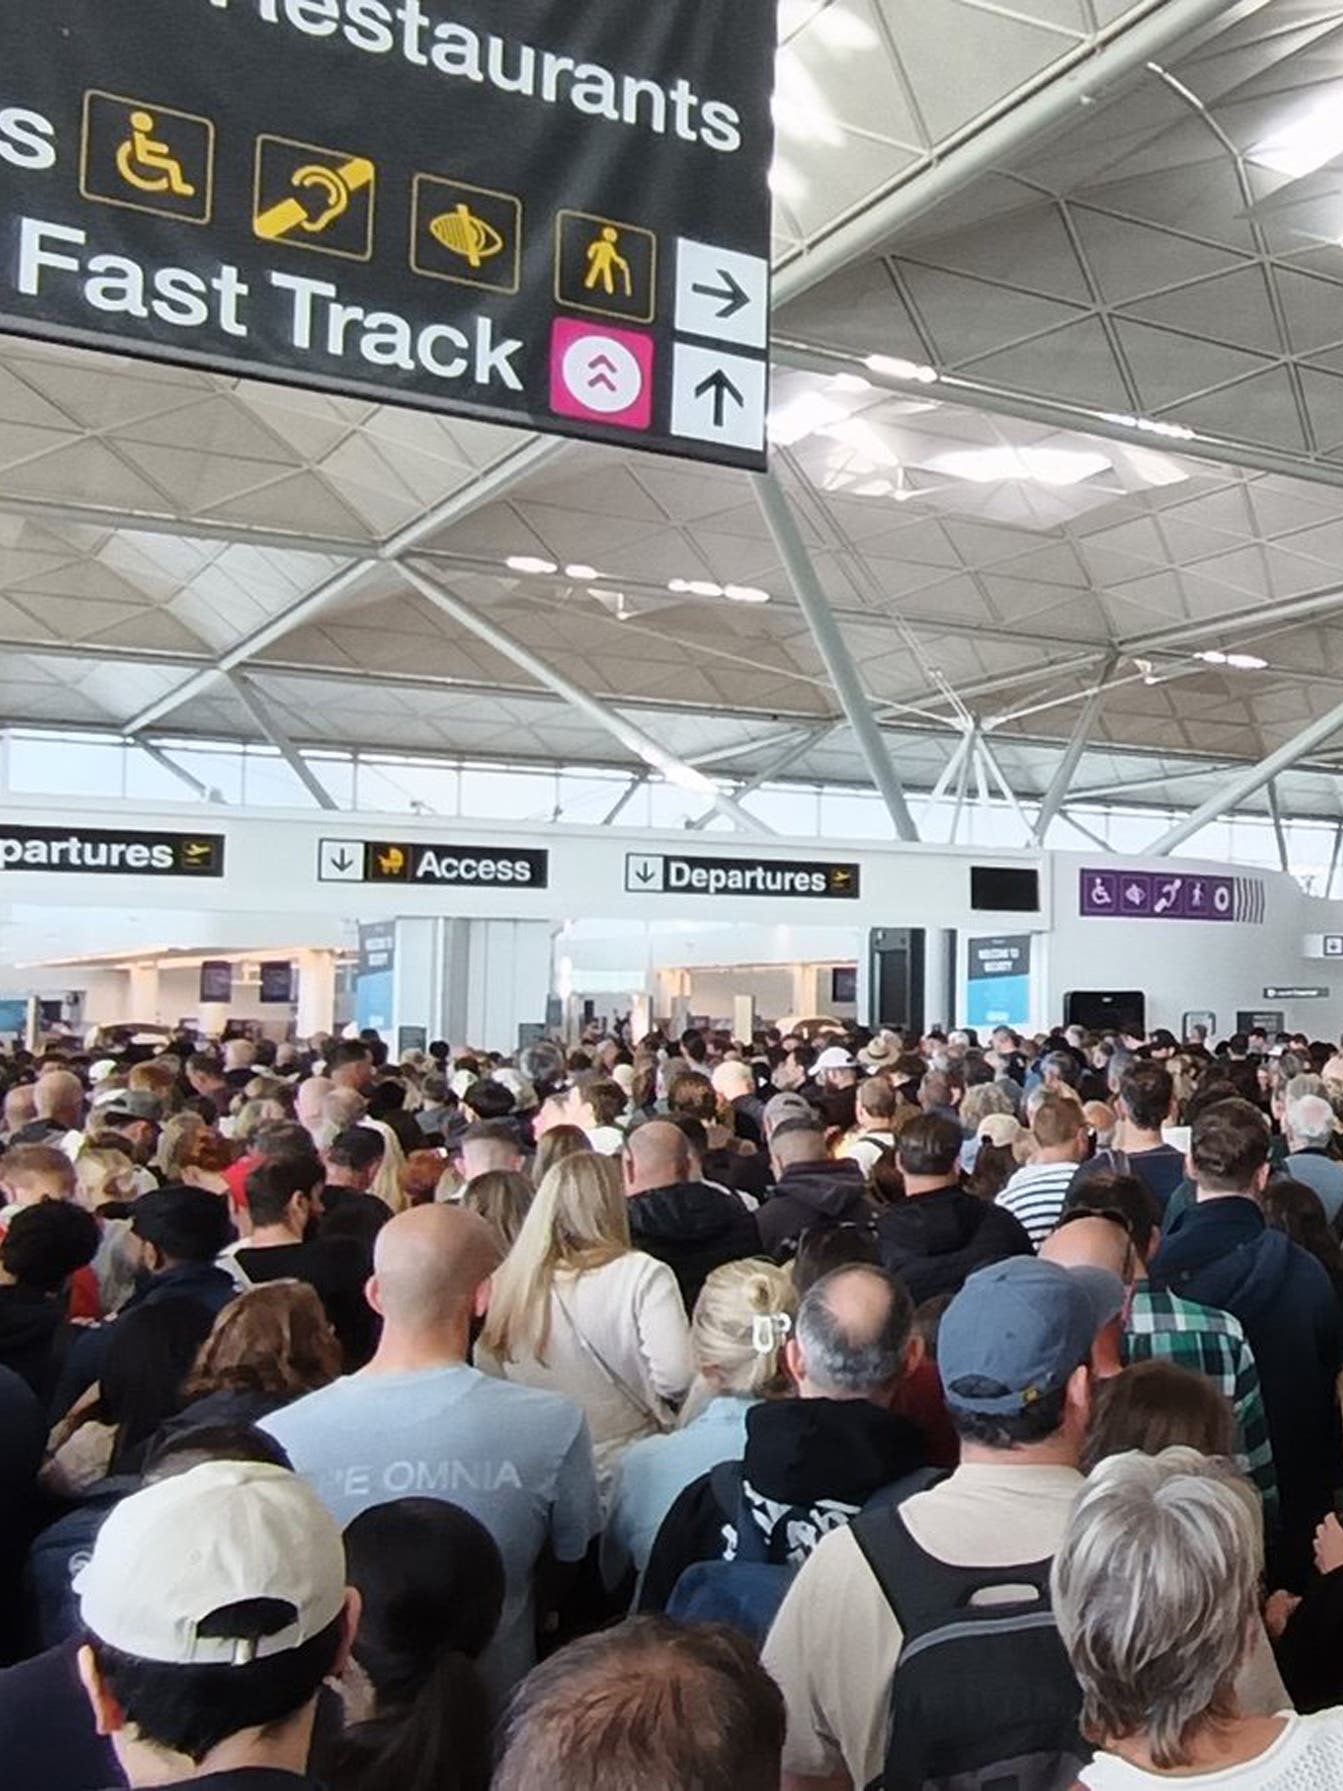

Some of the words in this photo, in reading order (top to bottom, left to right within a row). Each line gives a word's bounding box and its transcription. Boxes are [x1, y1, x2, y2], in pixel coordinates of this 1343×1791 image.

[17, 217, 248, 337] Fast
[272, 271, 524, 391] Track
[416, 851, 531, 882] Access
[668, 861, 826, 894] Departures
[383, 1460, 523, 1493] OMNIA
